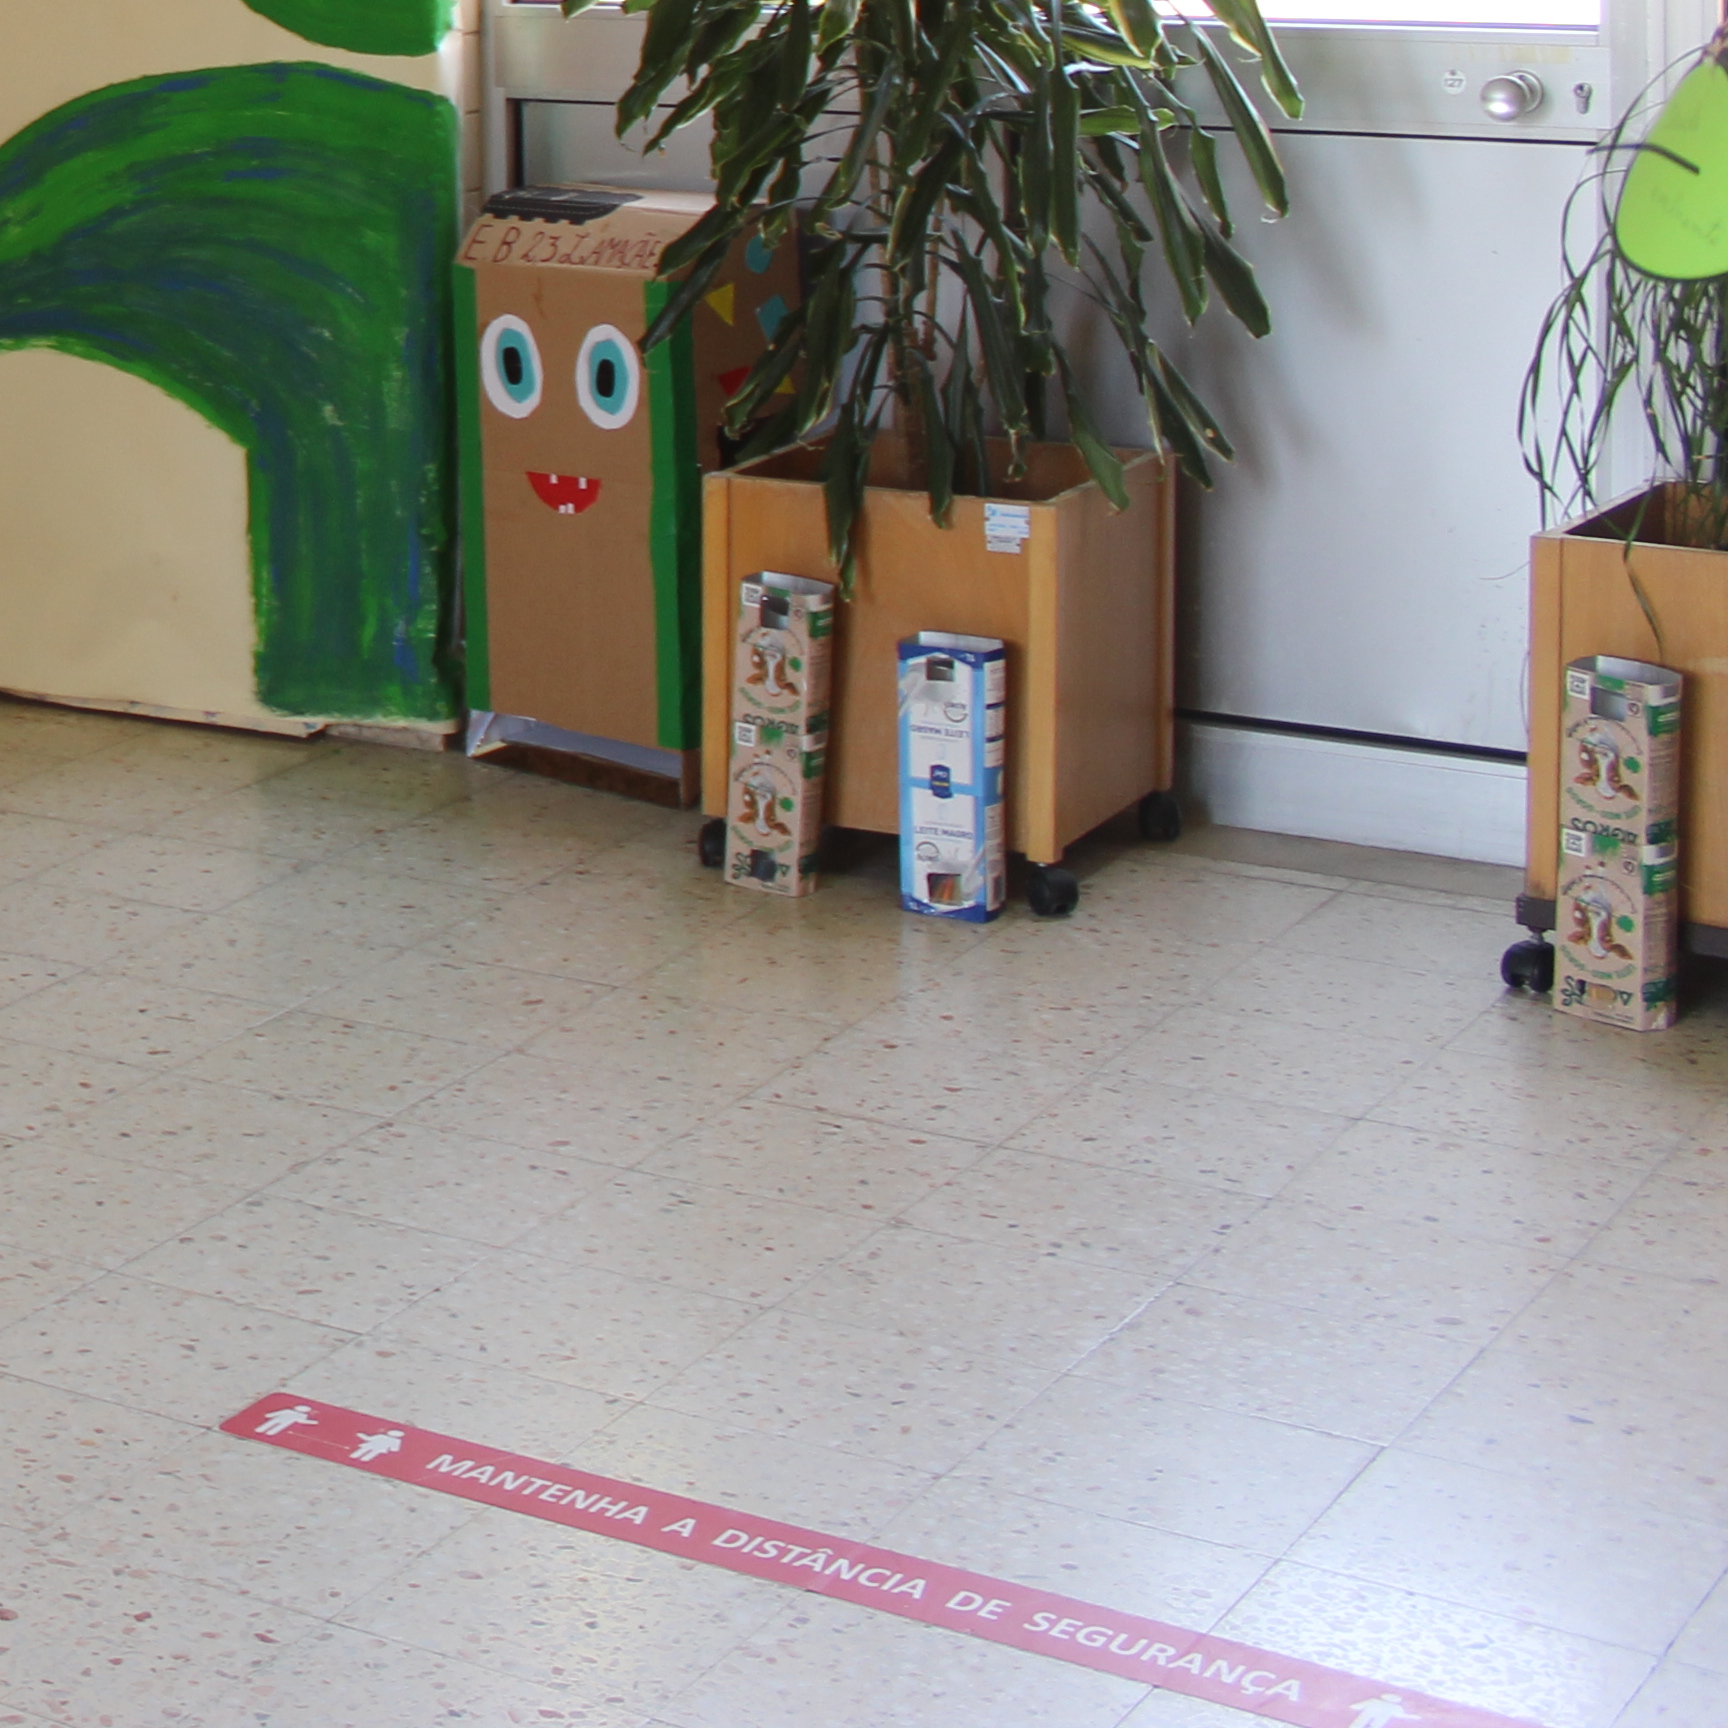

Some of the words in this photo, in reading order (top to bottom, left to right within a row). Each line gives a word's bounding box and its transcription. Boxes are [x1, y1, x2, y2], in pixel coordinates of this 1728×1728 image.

[426, 1454, 649, 1524] MANTENHA
[661, 1518, 697, 1538] A
[713, 1528, 924, 1599] DISTÂNCIA
[945, 1591, 1012, 1621] DE
[1023, 1611, 1302, 1702] SEGURANÇA
